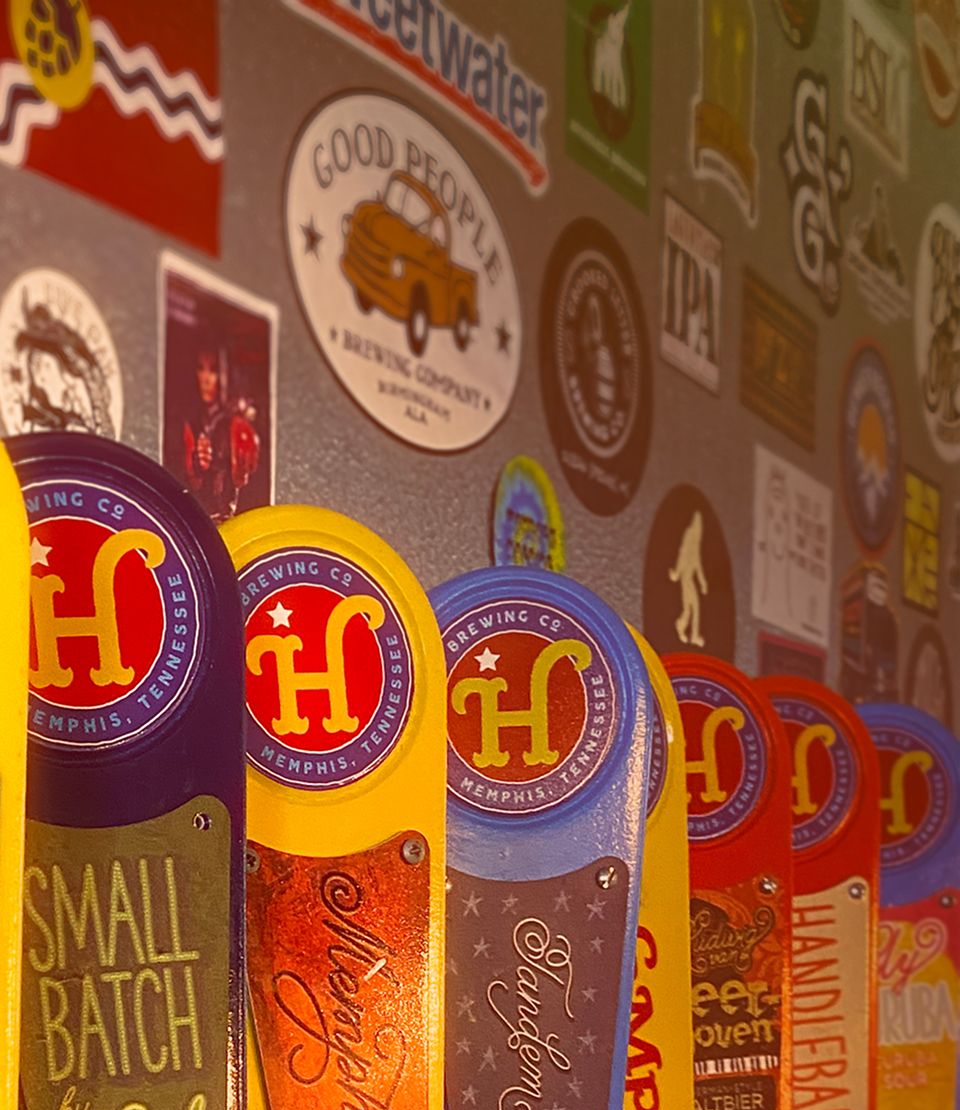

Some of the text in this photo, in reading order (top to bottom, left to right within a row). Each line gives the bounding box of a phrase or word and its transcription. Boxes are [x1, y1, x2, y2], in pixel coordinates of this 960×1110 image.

[351, 0, 545, 148] eetwater
[313, 124, 394, 189] GOOD
[406, 139, 503, 287] PEOPLE
[666, 234, 719, 368] IPA
[343, 329, 483, 412] BREWING COMPANY
[30, 528, 166, 689] H
[31, 573, 188, 734] EMPHIS, TENNESSEE
[245, 594, 386, 736] H
[446, 610, 528, 653] BREWING
[260, 635, 402, 776] MEMPHIS, TENNESSEE
[451, 639, 592, 768] H
[461, 674, 607, 803] MEMPHIS, TENNESSEE
[728, 733, 759, 816] TENNESSEE
[24, 856, 200, 973] SMALL
[40, 966, 202, 1082] BATCH
[695, 1017, 774, 1049] oven
[880, 981, 957, 1046] RUBA
